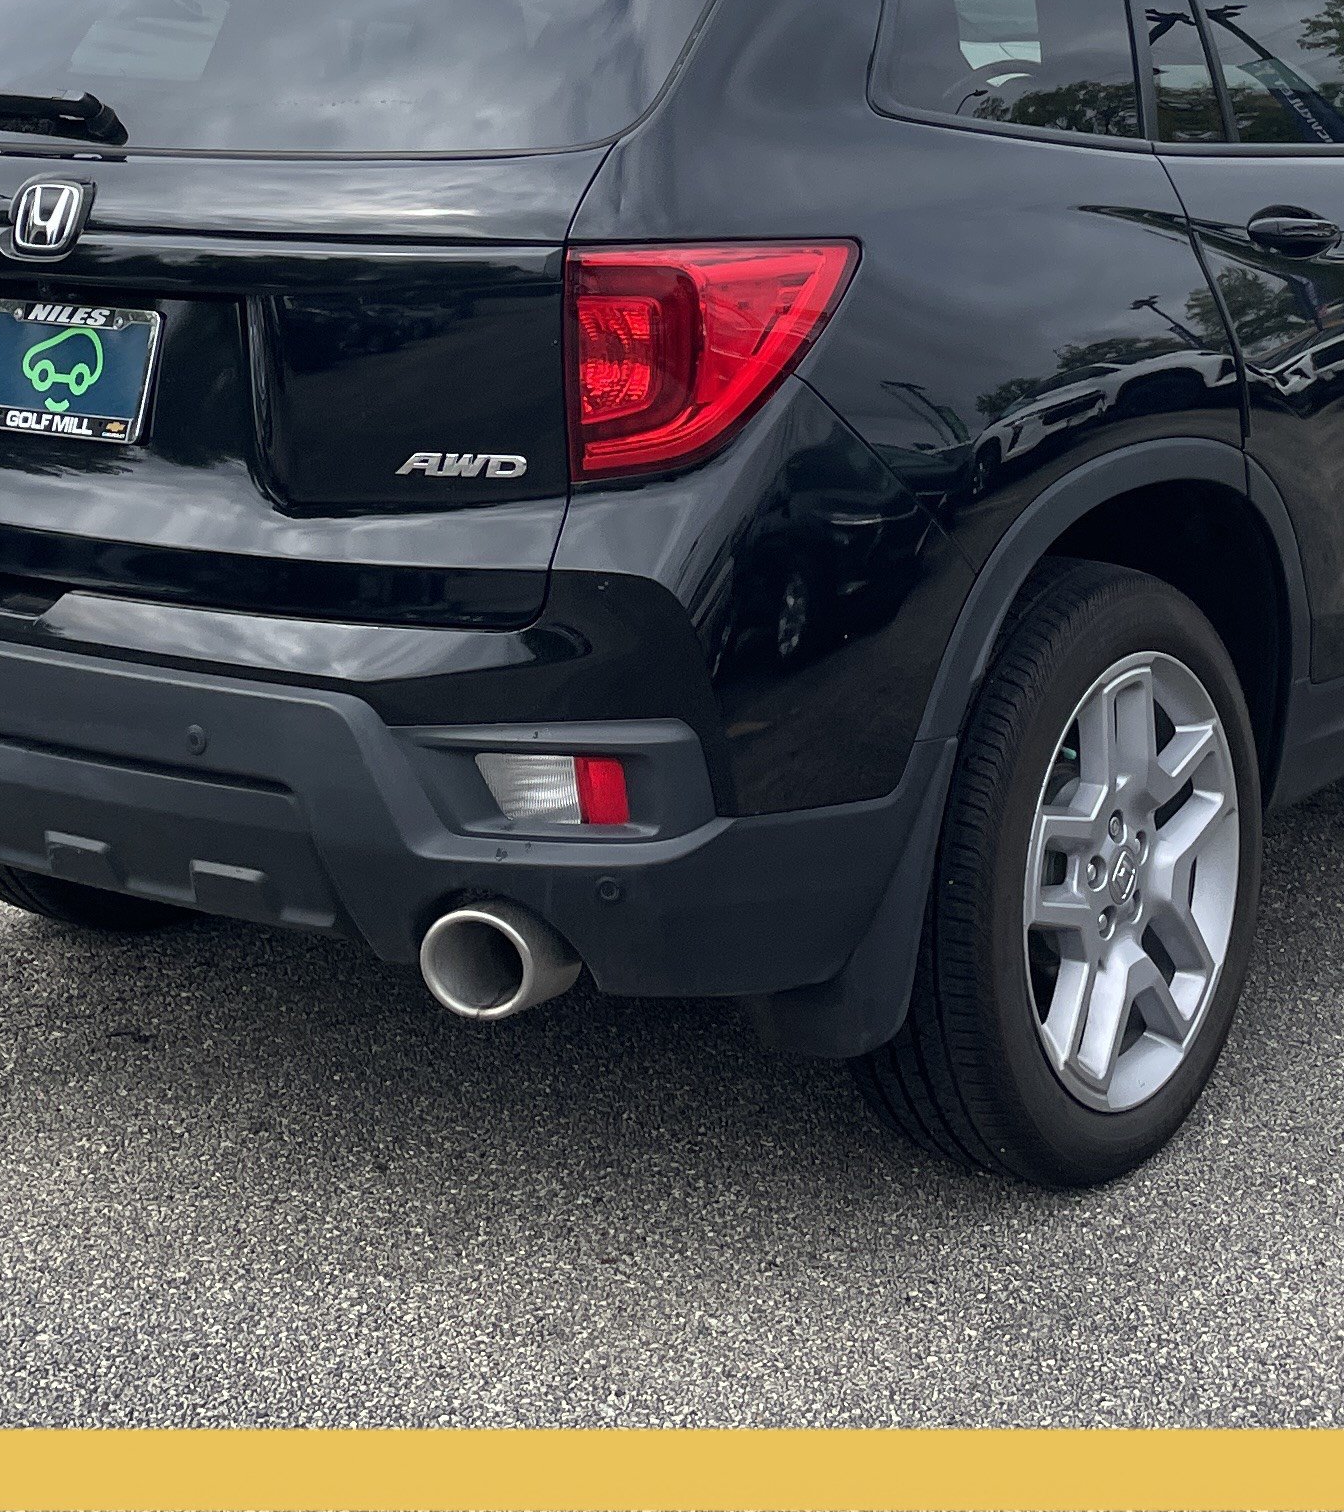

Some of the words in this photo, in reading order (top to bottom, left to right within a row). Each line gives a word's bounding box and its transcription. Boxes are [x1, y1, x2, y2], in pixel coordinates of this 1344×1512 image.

[28, 303, 111, 326] NILES
[6, 410, 52, 430] GOLF
[52, 415, 93, 436] MILL
[395, 452, 527, 478] AWD
